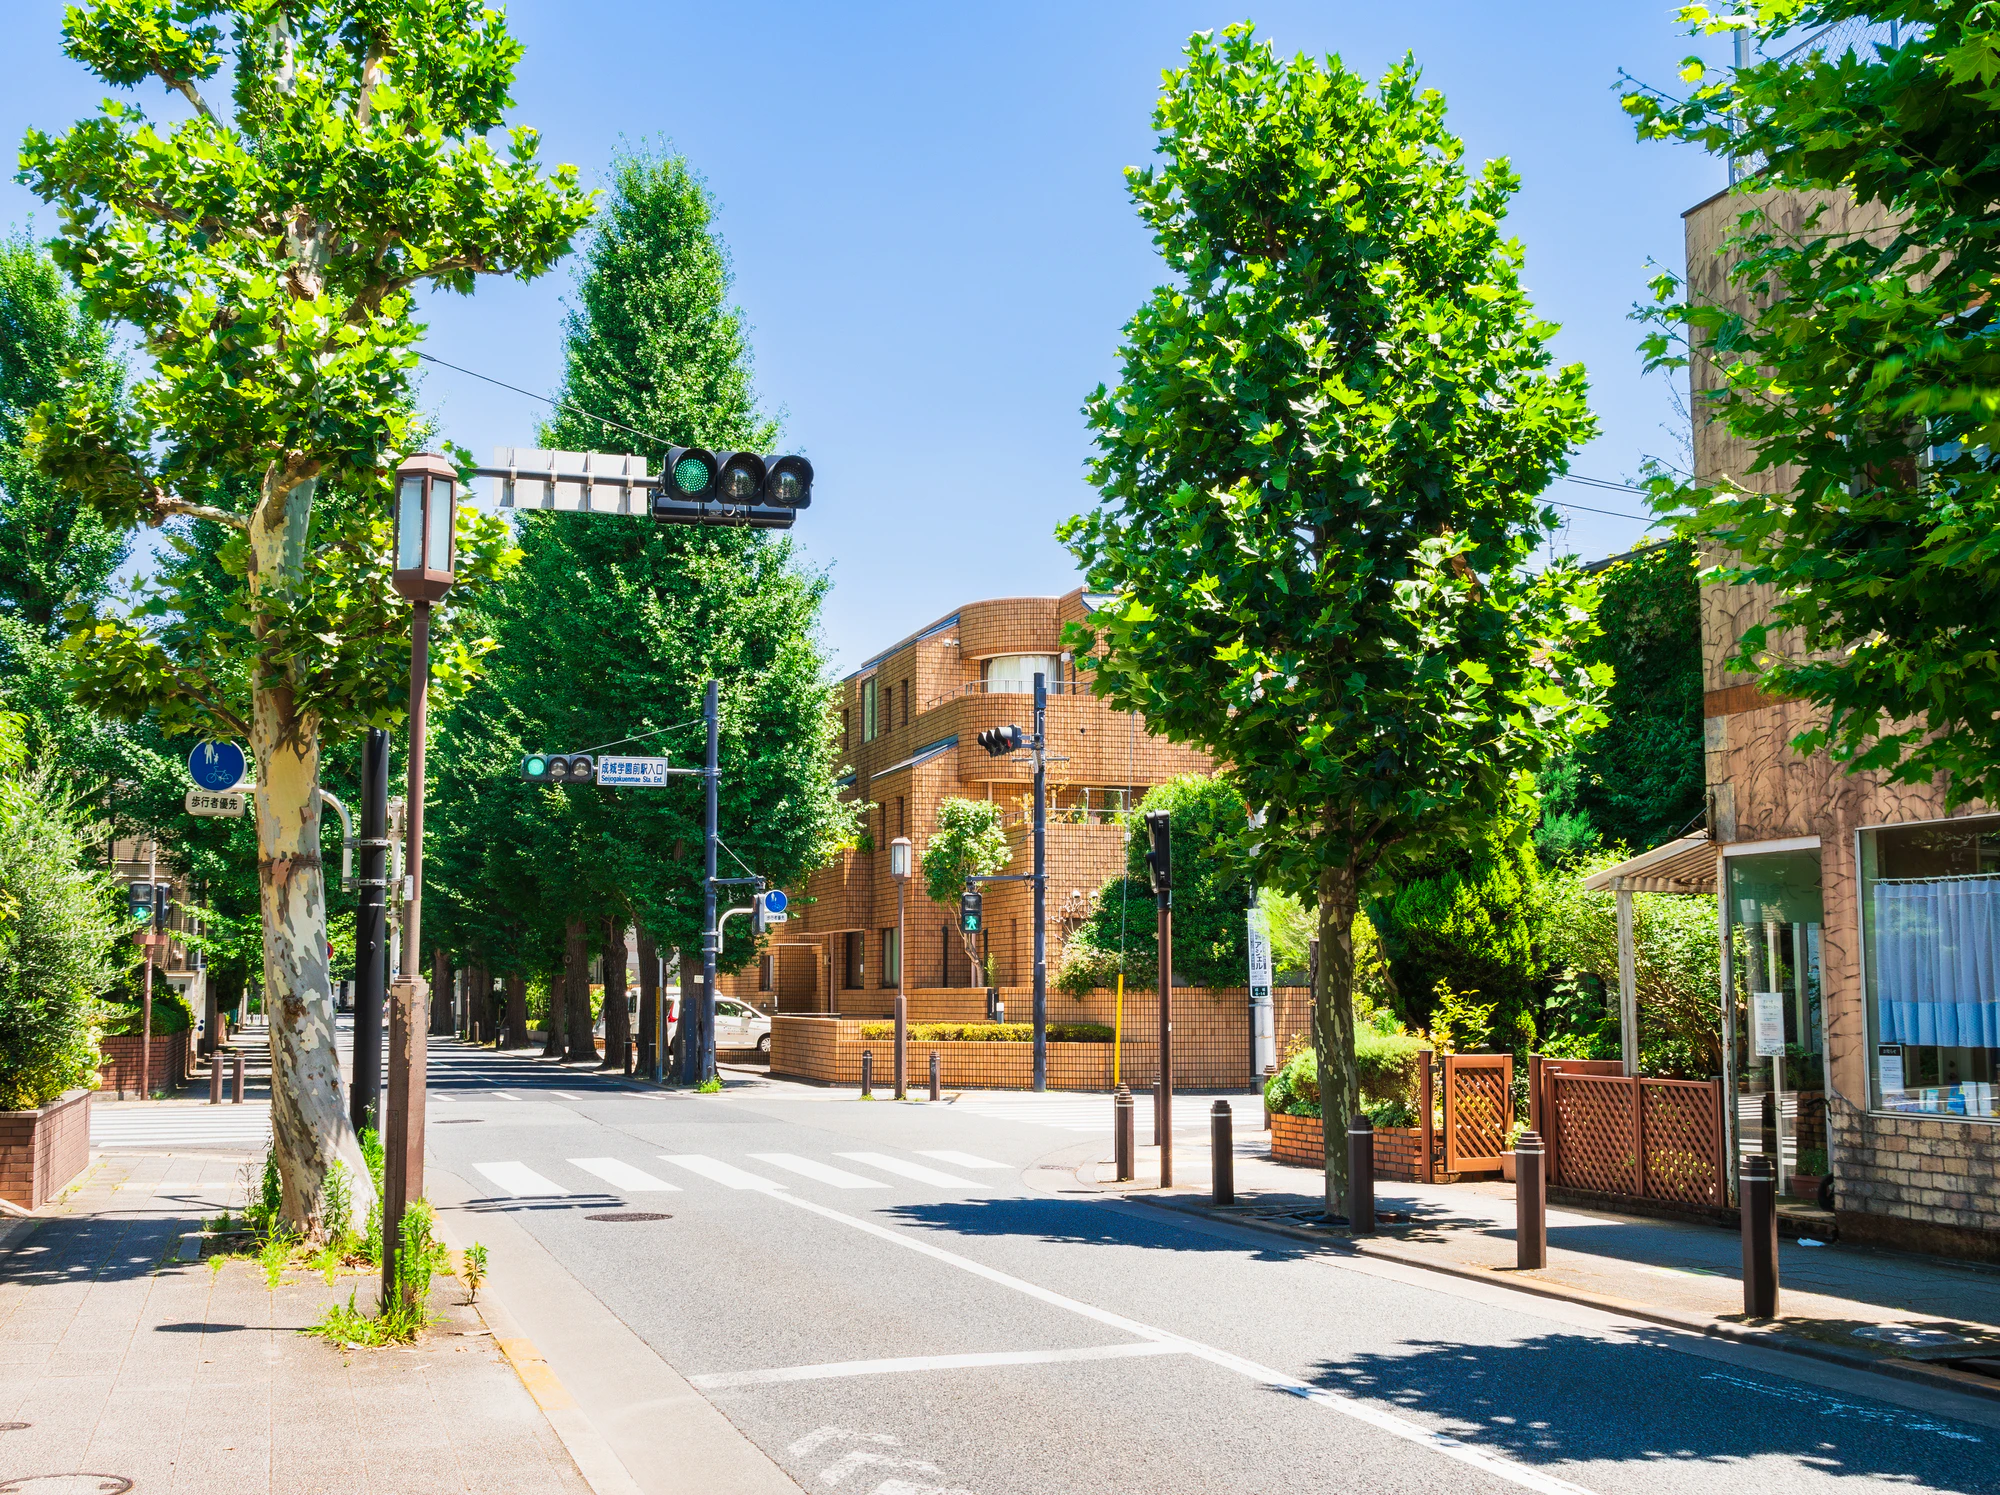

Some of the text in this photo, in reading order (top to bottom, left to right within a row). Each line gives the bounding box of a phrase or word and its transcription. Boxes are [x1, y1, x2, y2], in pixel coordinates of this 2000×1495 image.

[602, 762, 663, 774] 成城学園前駅入口
[191, 796, 238, 810] 歩行者優先
